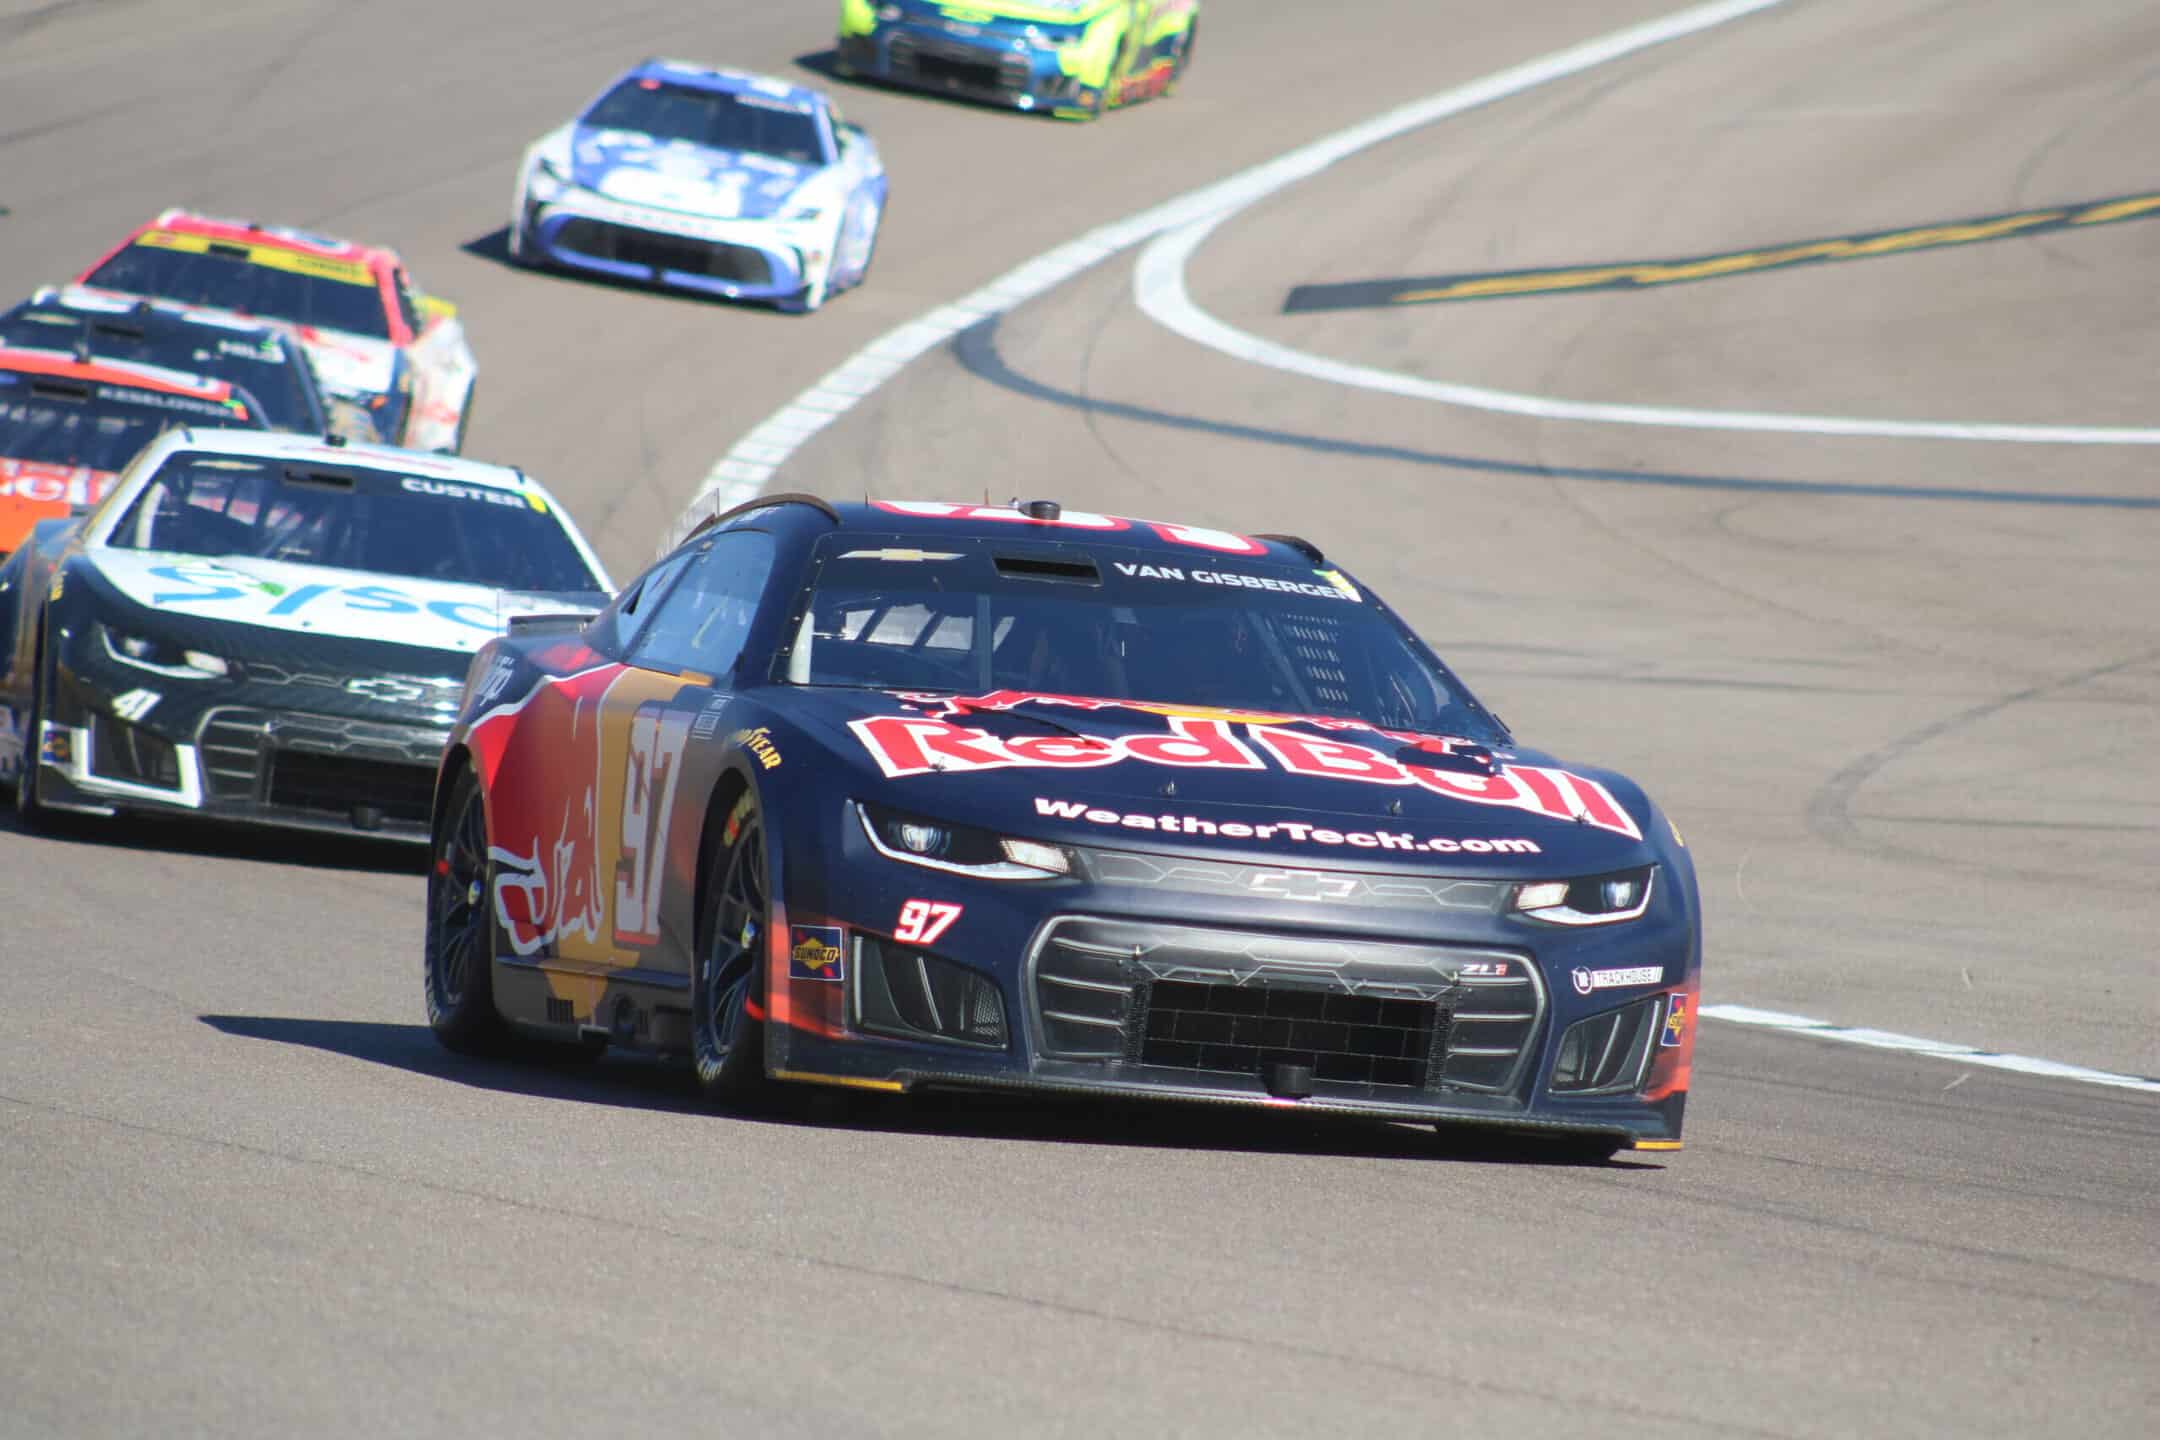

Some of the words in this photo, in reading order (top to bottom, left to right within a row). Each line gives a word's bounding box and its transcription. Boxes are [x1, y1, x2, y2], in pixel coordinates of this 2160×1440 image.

[401, 477, 526, 509] CUSTER
[147, 565, 512, 634] Sysc
[1113, 561, 1185, 580] VAN
[1191, 570, 1358, 601] GISBERGEN
[111, 688, 162, 722] 41
[846, 716, 1268, 779] Red
[1244, 722, 1643, 841] Bull
[613, 706, 698, 945] 97
[1033, 797, 1542, 855] WeatherTech.com
[894, 899, 964, 944] 97
